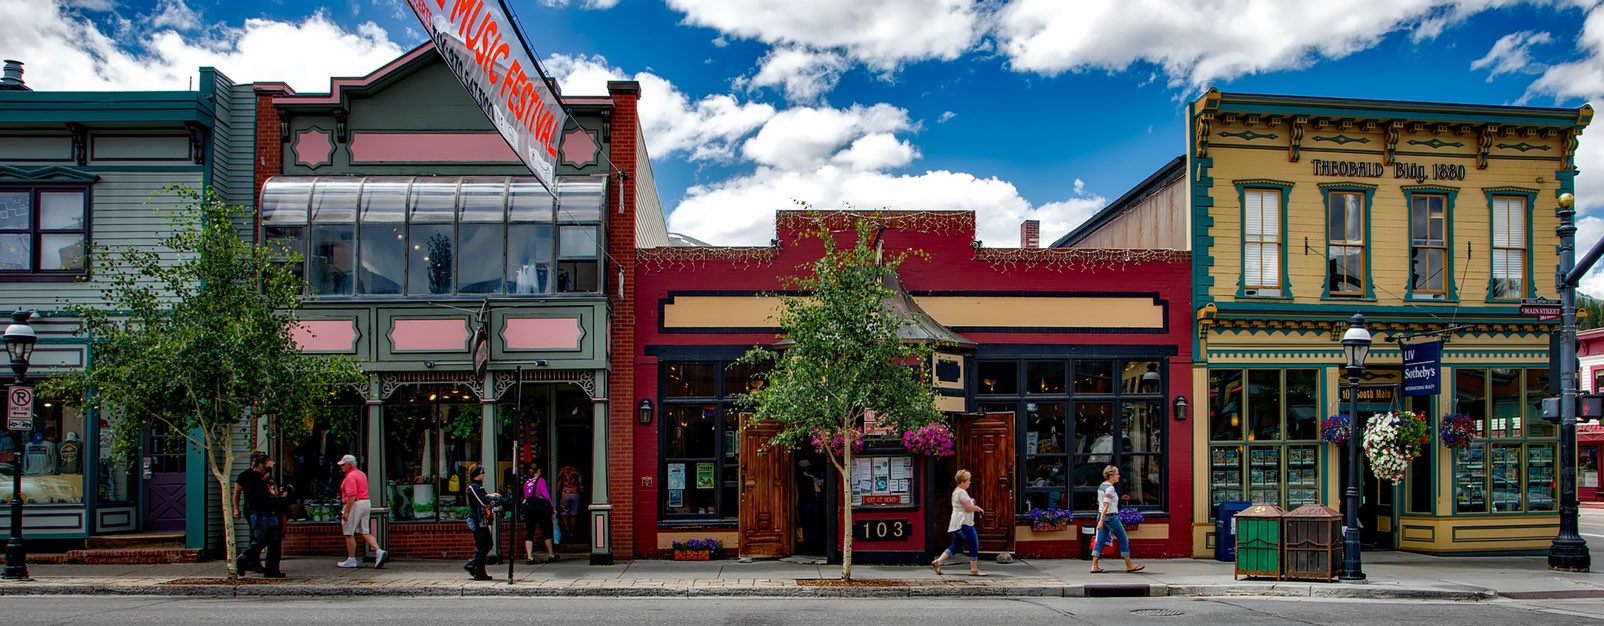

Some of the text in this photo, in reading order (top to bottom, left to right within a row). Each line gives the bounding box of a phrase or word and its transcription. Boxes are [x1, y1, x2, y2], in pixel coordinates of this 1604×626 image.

[449, 0, 559, 158] MUSIC FESTIVAL
[1312, 159, 1466, 184] THEOBALD Bldg. 1880
[1524, 307, 1539, 315] MAIN
[1404, 350, 1415, 360] LIV
[1404, 366, 1436, 380] Sotheby's
[1342, 388, 1392, 399] 10 South Main
[863, 521, 903, 539] 103
